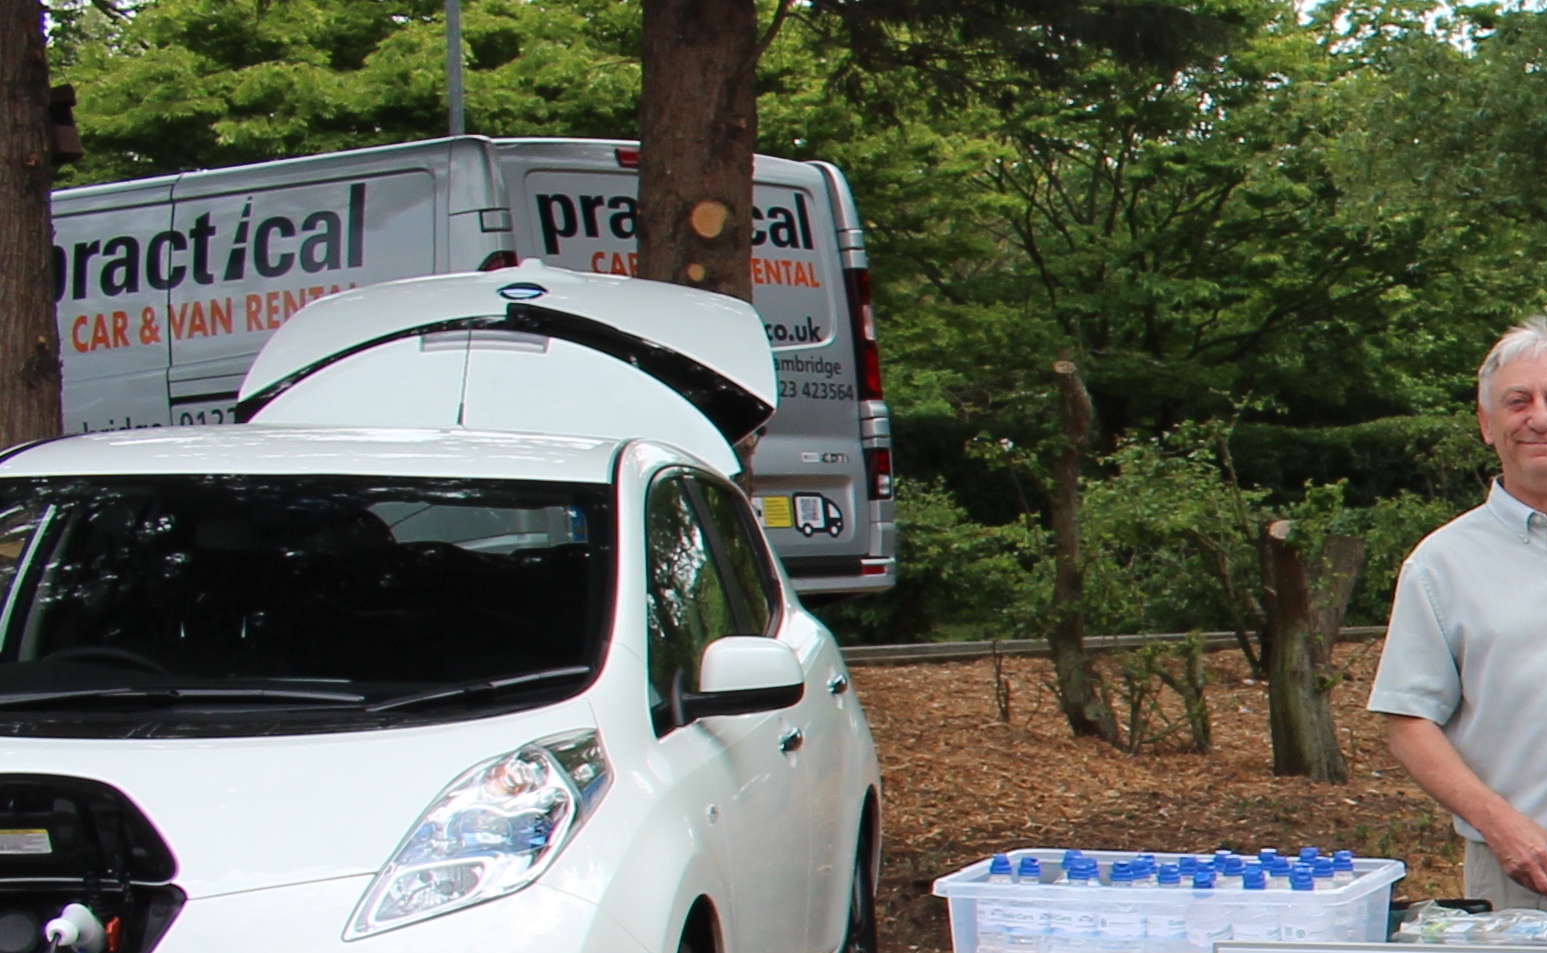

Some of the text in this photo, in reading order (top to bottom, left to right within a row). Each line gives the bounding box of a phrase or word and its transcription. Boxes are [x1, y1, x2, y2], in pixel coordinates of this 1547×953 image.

[536, 194, 814, 256] pracal
[752, 258, 820, 289] ENTAL
[71, 285, 358, 353] CAR & VAN REN
[765, 316, 822, 342] co.uk
[774, 355, 842, 378] ambridge
[779, 381, 854, 400] 23 423564
